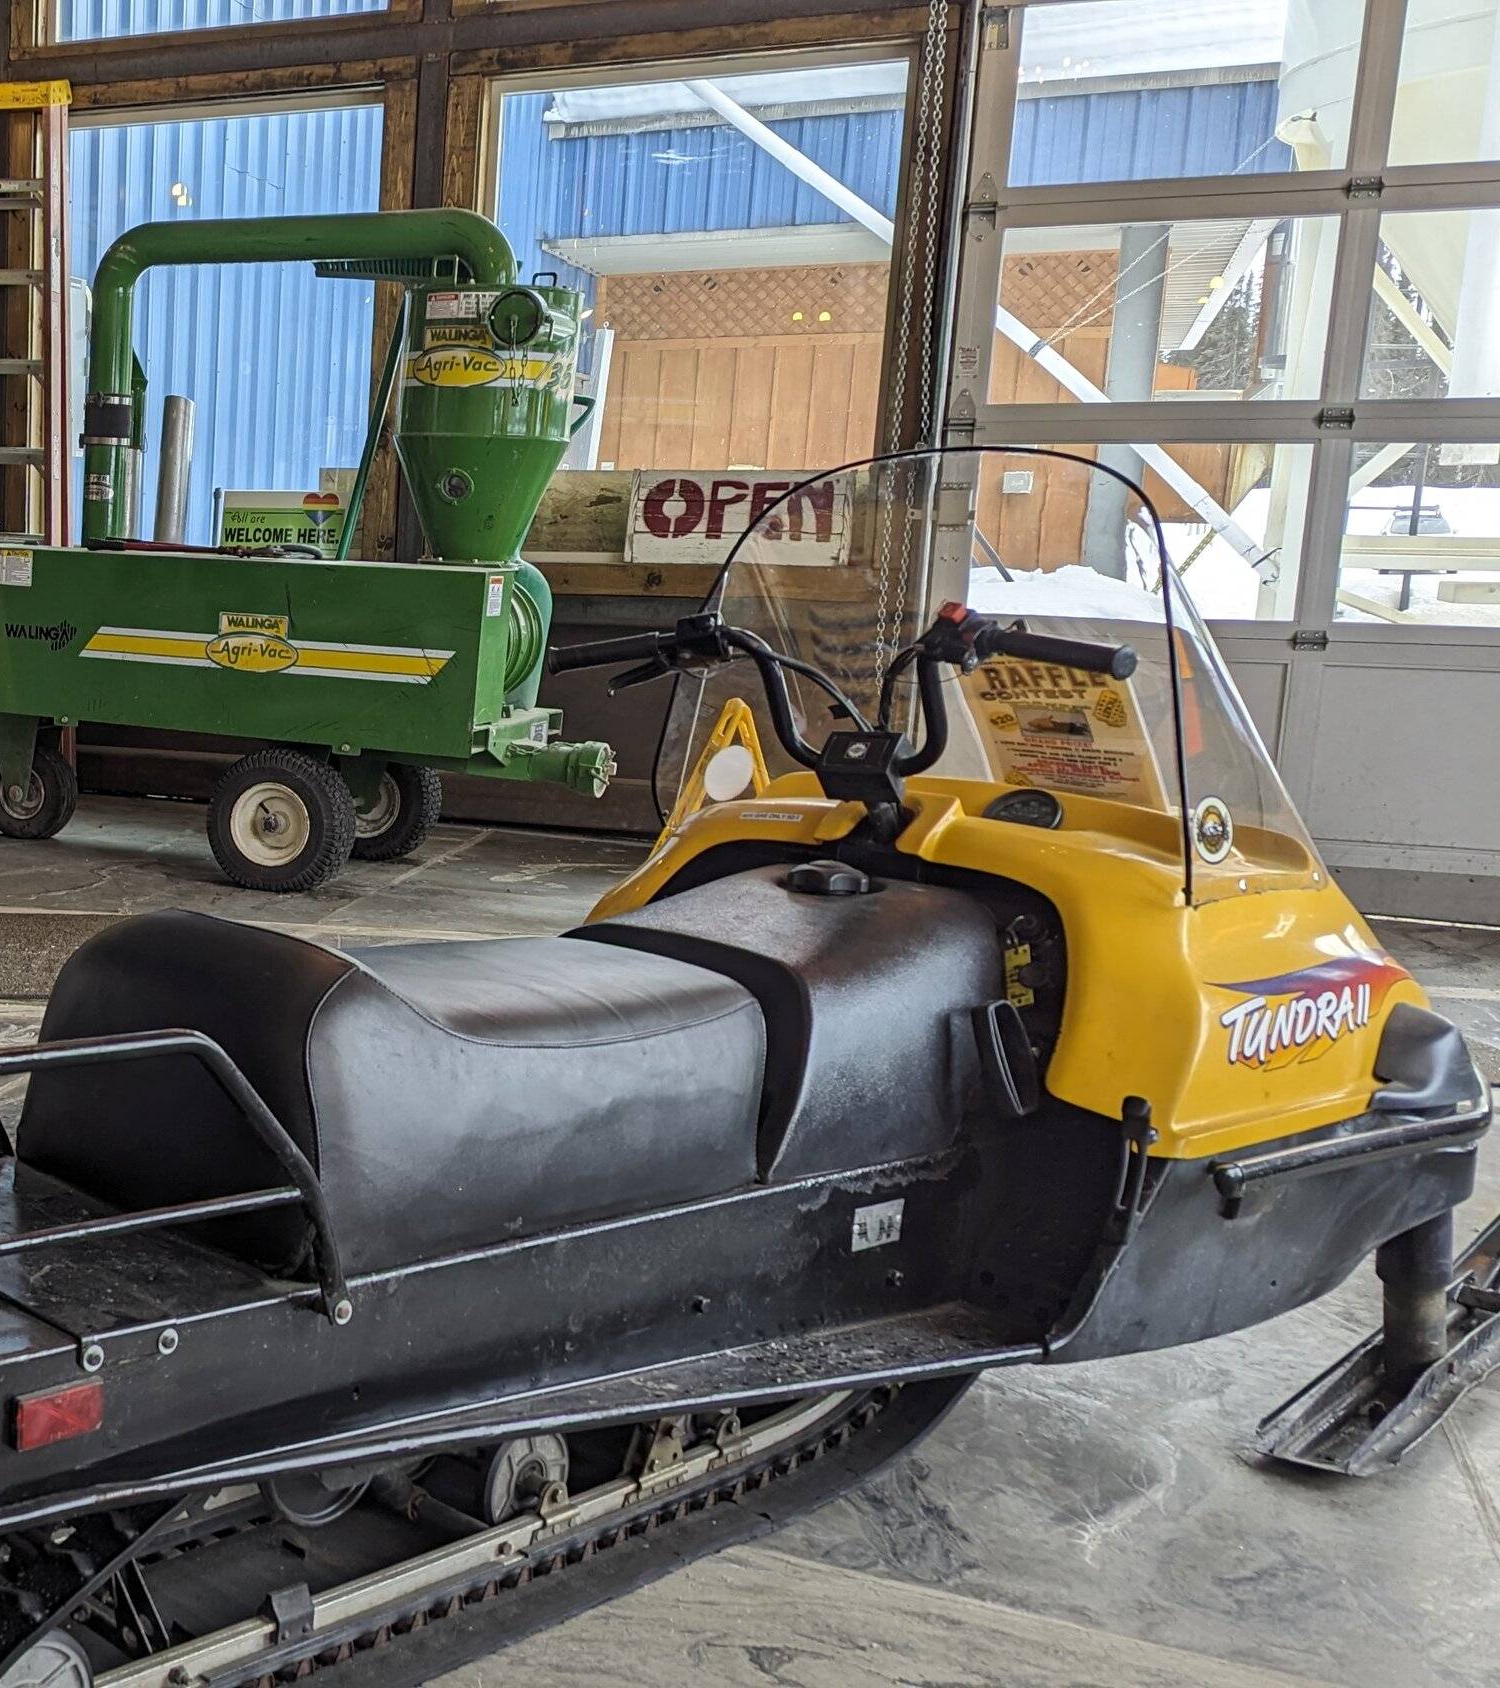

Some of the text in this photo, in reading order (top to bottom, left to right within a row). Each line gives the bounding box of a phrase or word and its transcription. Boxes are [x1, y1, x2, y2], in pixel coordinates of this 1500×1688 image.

[430, 328, 487, 345] WALINGA
[416, 355, 501, 382] Agri-Vac
[231, 511, 266, 524] All are
[643, 478, 835, 543] OPEN
[224, 527, 340, 545] WELCOME HERE.
[4, 622, 71, 642] WALINGA
[226, 615, 280, 630] WALINGA
[210, 640, 292, 665] Agri-Vac
[980, 665, 1109, 691] RAFFLE
[980, 689, 1087, 701] CONTEST
